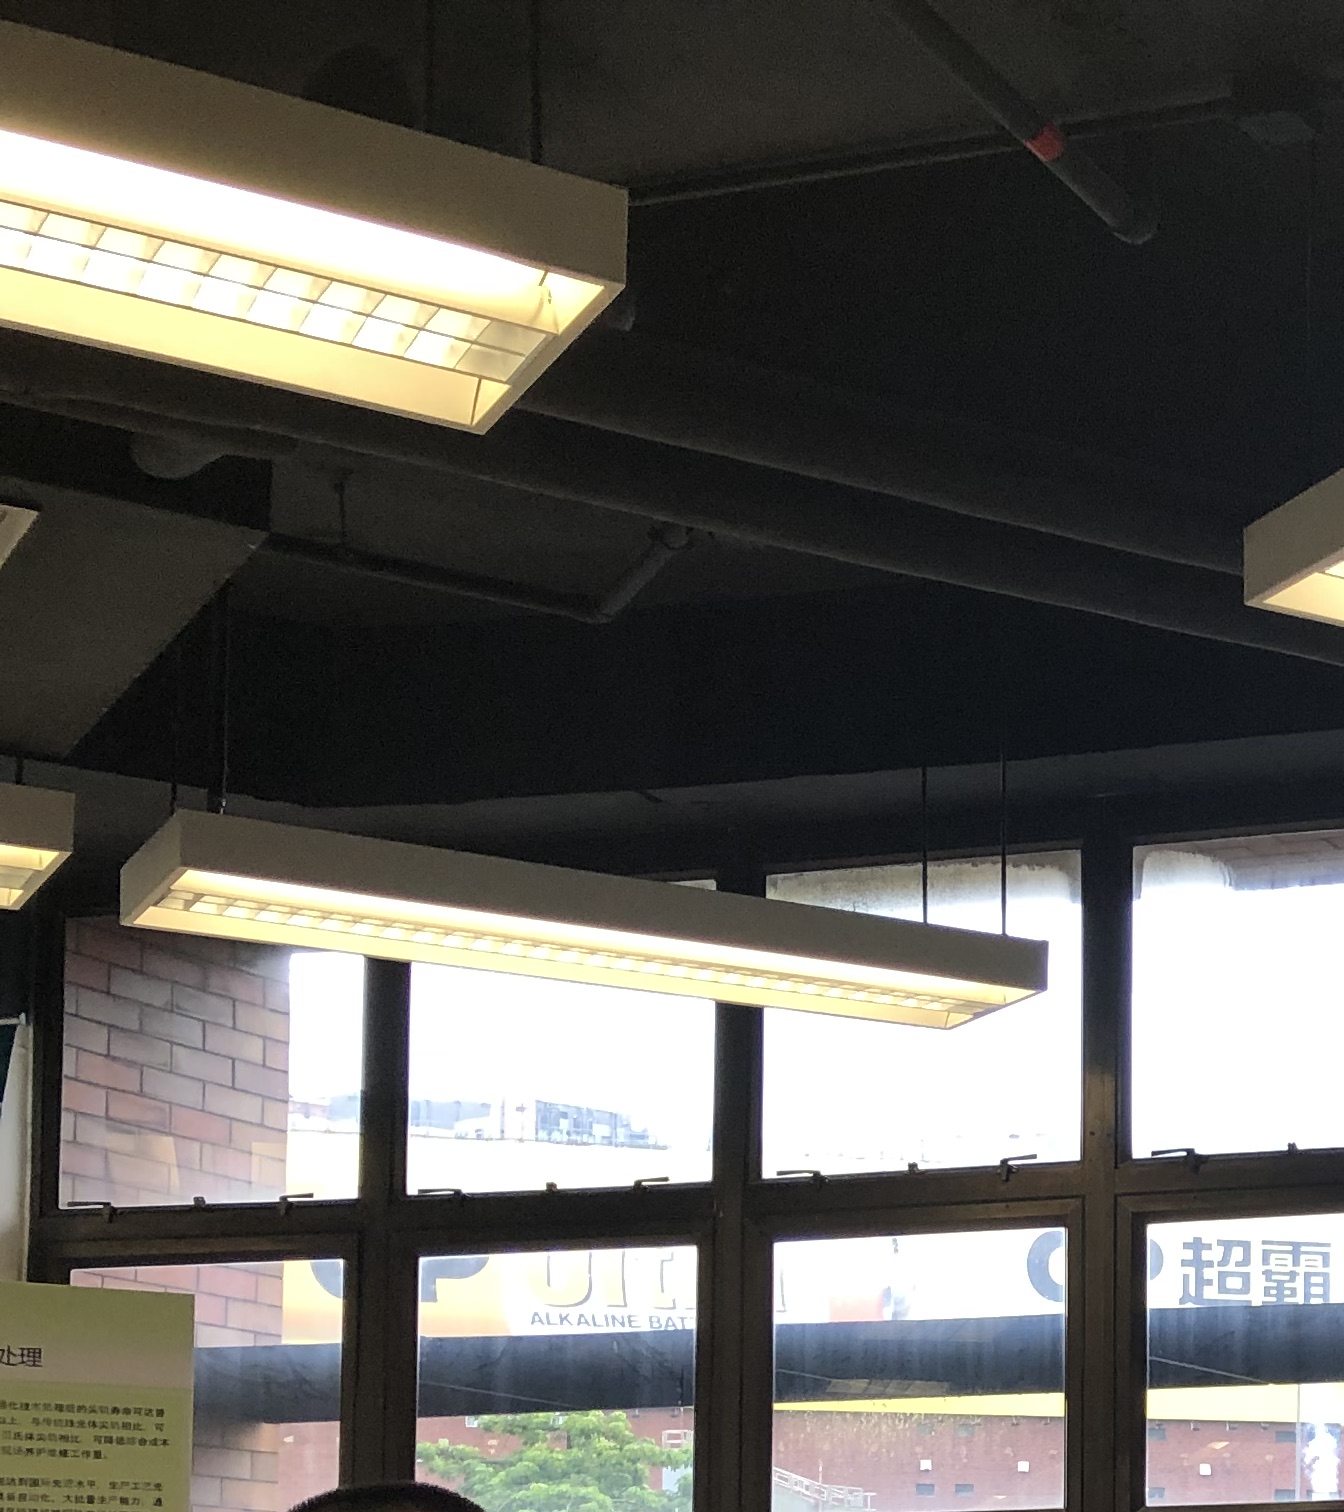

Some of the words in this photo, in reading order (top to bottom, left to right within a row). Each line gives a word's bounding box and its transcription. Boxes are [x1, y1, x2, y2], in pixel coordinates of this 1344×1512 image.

[1179, 1236, 1332, 1306] 超霸
[531, 1311, 642, 1330] ALKALINE
[648, 1315, 694, 1329] BAT
